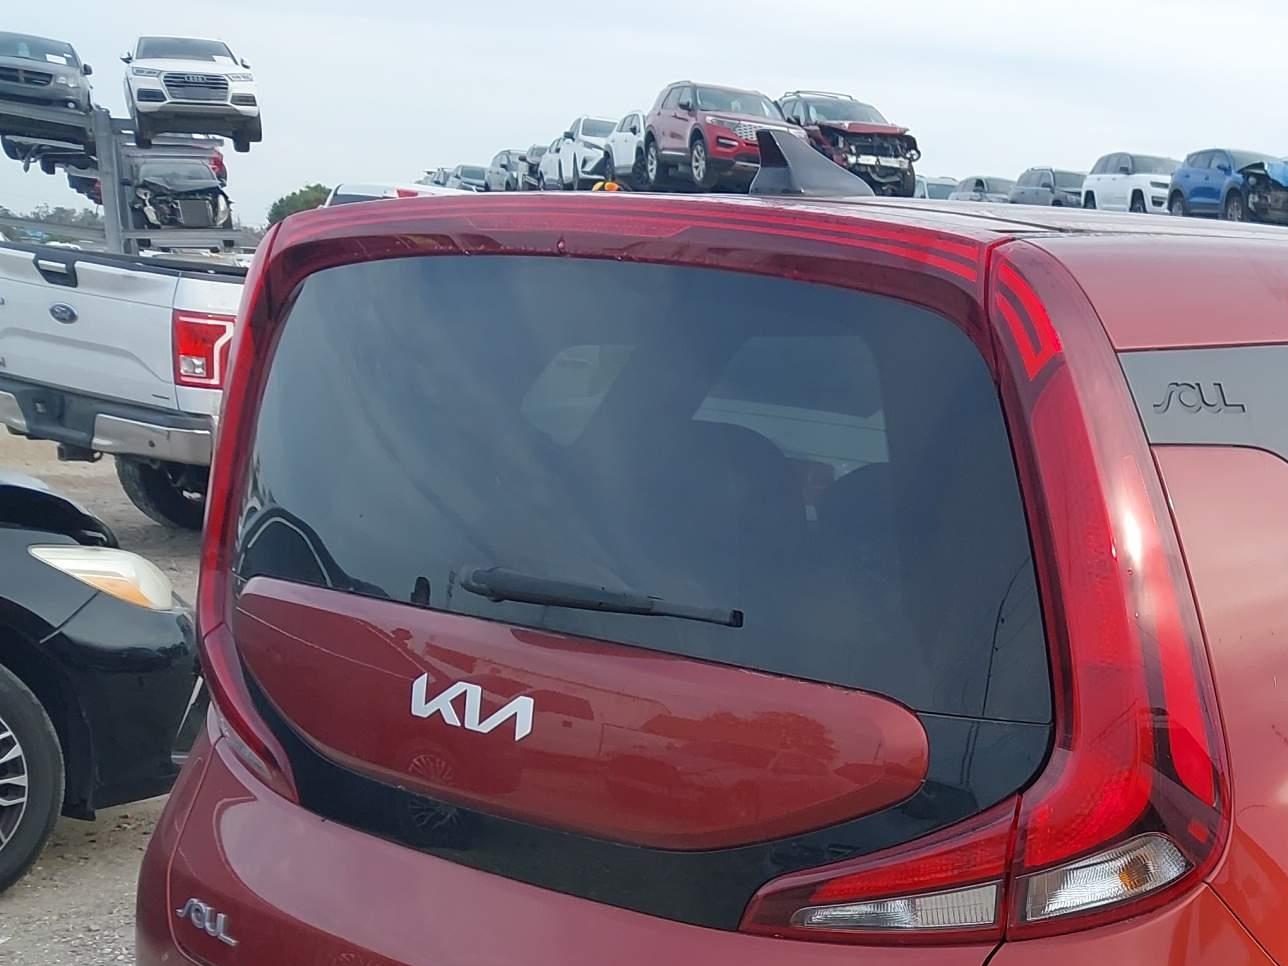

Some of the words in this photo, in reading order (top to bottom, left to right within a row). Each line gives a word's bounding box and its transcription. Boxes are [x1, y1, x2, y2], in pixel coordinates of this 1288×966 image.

[1152, 382, 1246, 414] SOUL
[411, 672, 534, 742] KIA
[175, 897, 239, 947] SOUL
